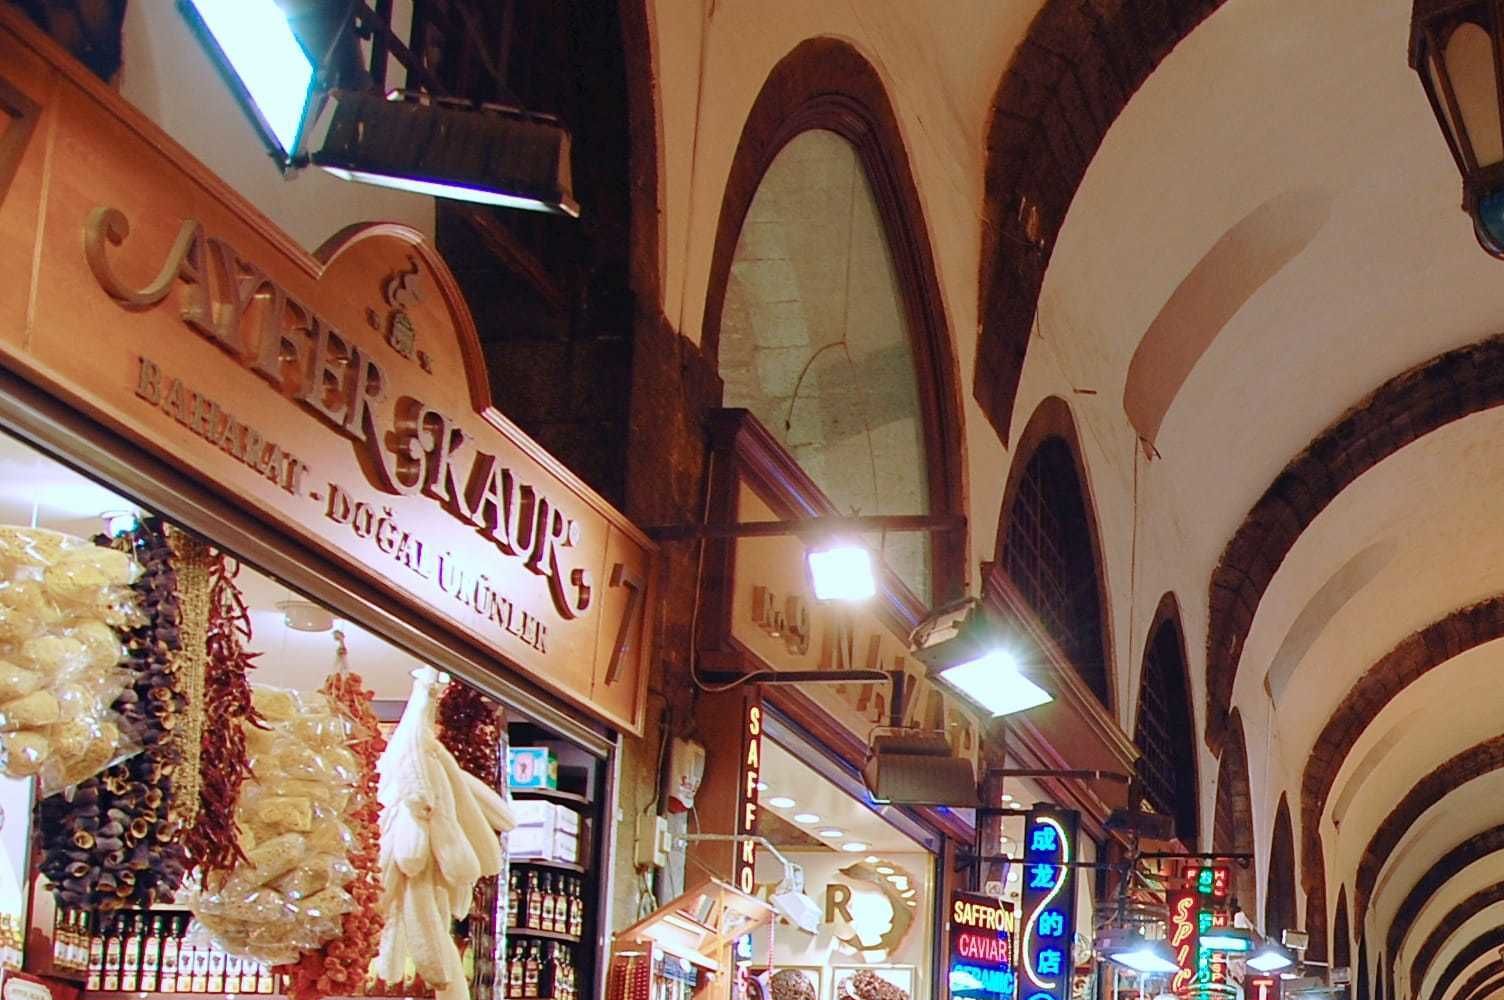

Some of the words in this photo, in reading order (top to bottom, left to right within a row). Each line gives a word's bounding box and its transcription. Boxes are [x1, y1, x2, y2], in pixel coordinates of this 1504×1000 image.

[84, 206, 404, 497] AYFER
[134, 354, 311, 497] BAHARAT
[325, 482, 430, 582] DOĞAL
[741, 706, 761, 894] SAFFRO
[954, 900, 1014, 932] SAFFRON
[959, 933, 1008, 962] CAVIAR
[1172, 898, 1194, 993] SPIC
[953, 965, 1014, 995] RAMIC
